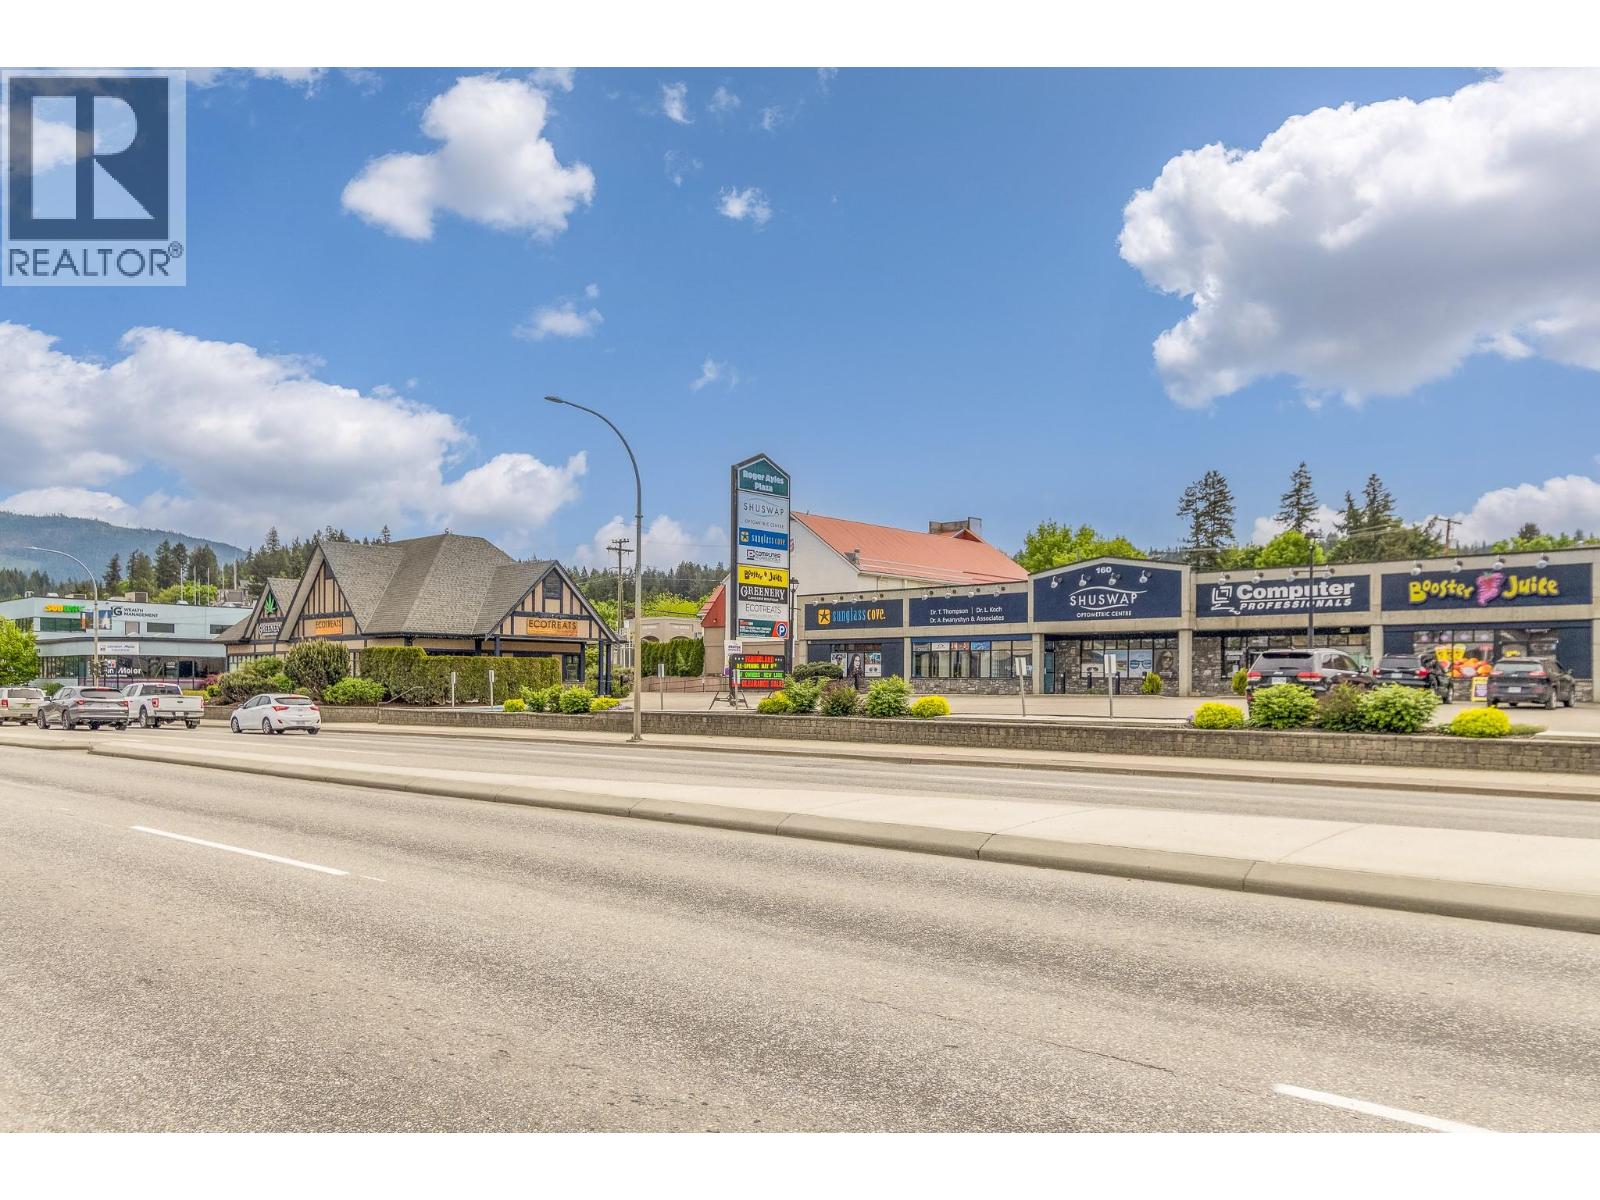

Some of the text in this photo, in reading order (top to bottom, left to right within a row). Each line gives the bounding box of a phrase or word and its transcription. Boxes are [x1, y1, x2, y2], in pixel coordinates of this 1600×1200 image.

[754, 482, 773, 492] Plaza
[743, 502, 785, 516] SHUSWAP
[768, 572, 783, 582] Juice
[740, 585, 785, 600] GREENERY
[1236, 581, 1355, 600] Computer
[1409, 575, 1560, 603] Booster Juice
[1069, 592, 1138, 607] SHUSWAP
[745, 603, 782, 615] ECOTREATS
[832, 607, 866, 622] sunglass
[528, 619, 577, 630] ECOTREATS
[976, 614, 1005, 622] Associates
